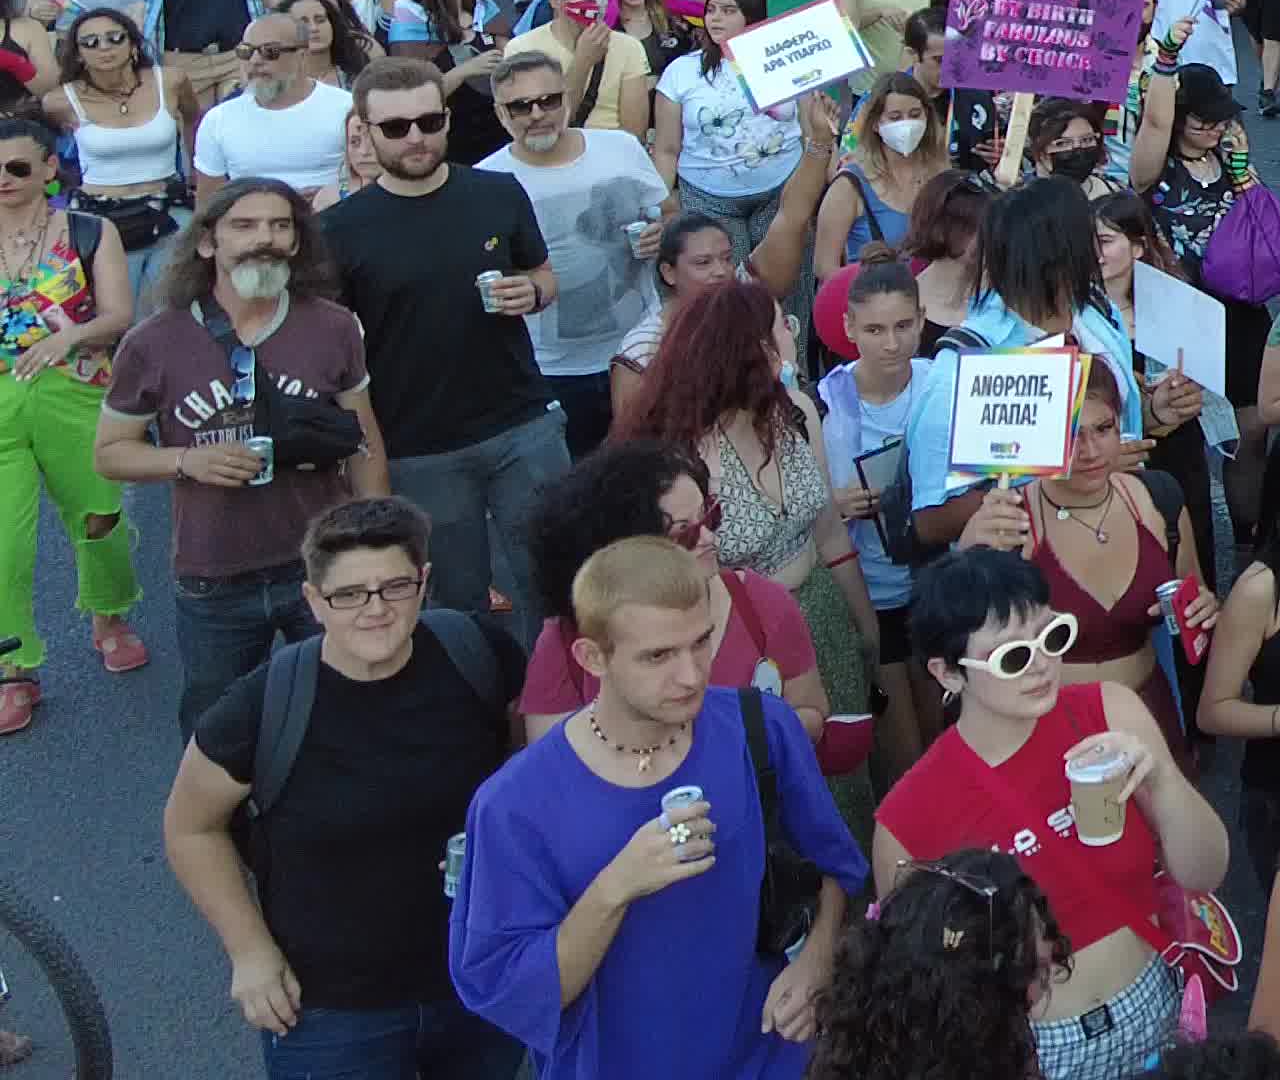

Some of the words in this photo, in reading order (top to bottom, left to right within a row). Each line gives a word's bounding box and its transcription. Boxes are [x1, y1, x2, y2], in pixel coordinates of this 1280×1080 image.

[1026, 2, 1097, 26] BIRTH
[983, 20, 1093, 49] FABULOUS
[980, 42, 1010, 63] BY
[1015, 47, 1092, 71] CHOICE
[970, 374, 1053, 404] ΑΝΘΡΩΠΕ,
[980, 403, 1037, 426] ΑΓΑΠΑ!
